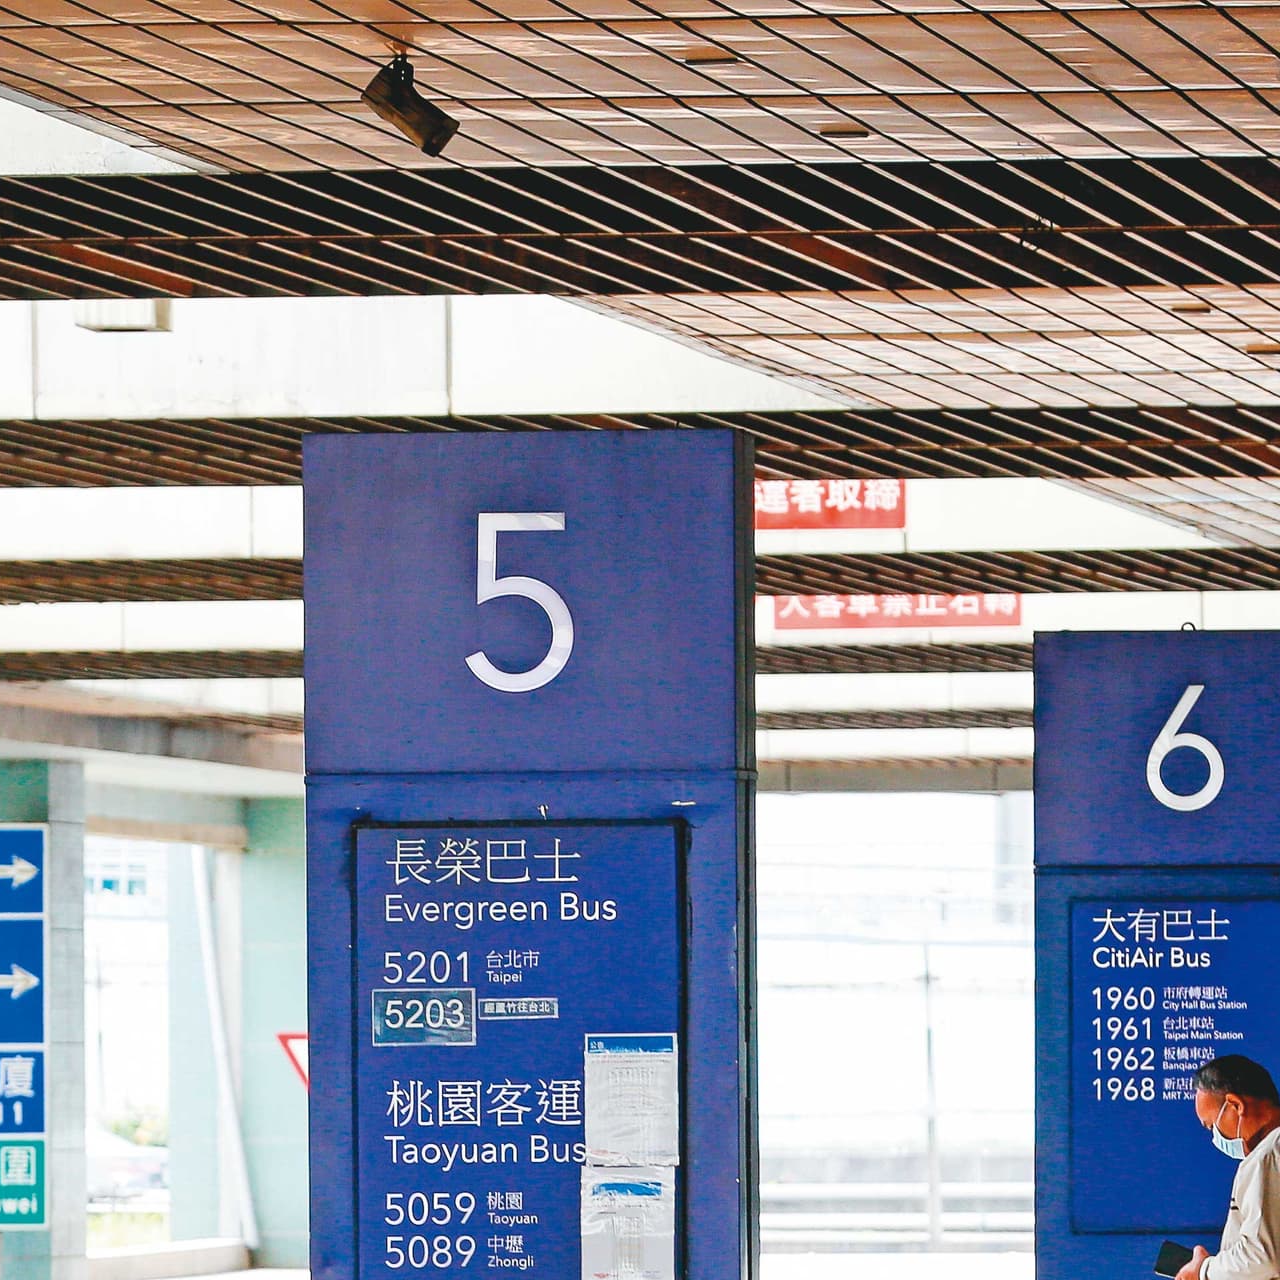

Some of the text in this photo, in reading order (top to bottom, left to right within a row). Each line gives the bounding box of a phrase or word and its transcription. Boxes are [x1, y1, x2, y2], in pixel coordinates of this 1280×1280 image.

[464, 512, 575, 693] 5
[1145, 684, 1226, 812] 6
[385, 837, 582, 886] 長榮巴士
[385, 892, 618, 930] Evergreen Bus
[1092, 908, 1231, 943] 大有巴士
[383, 951, 469, 984] 5201
[486, 949, 540, 968] 台北市
[1092, 946, 1212, 969] CitiAir Bus
[486, 970, 523, 984] Taipei
[1092, 986, 1156, 1011] 1960
[1162, 1000, 1248, 1011] City Hall Bus Station
[384, 998, 466, 1029] 5203
[1162, 1016, 1215, 1030] 台北車站
[1092, 1017, 1152, 1041] 1961
[1163, 1030, 1244, 1041] Taipei Main Station
[1092, 1047, 1155, 1071] 1962
[1162, 1061, 1198, 1072] Banqiao
[1092, 1077, 1156, 1102] 1968
[1162, 1091, 1182, 1101] MRT
[12, 1101, 24, 1126] 1
[386, 1078, 582, 1129] 桃園客運
[384, 1134, 585, 1172] Taoyuan Bus
[384, 1192, 476, 1226] 5059
[487, 1213, 539, 1228] Taoyuan
[384, 1235, 476, 1269] 5089
[487, 1255, 535, 1271] Zhongli
